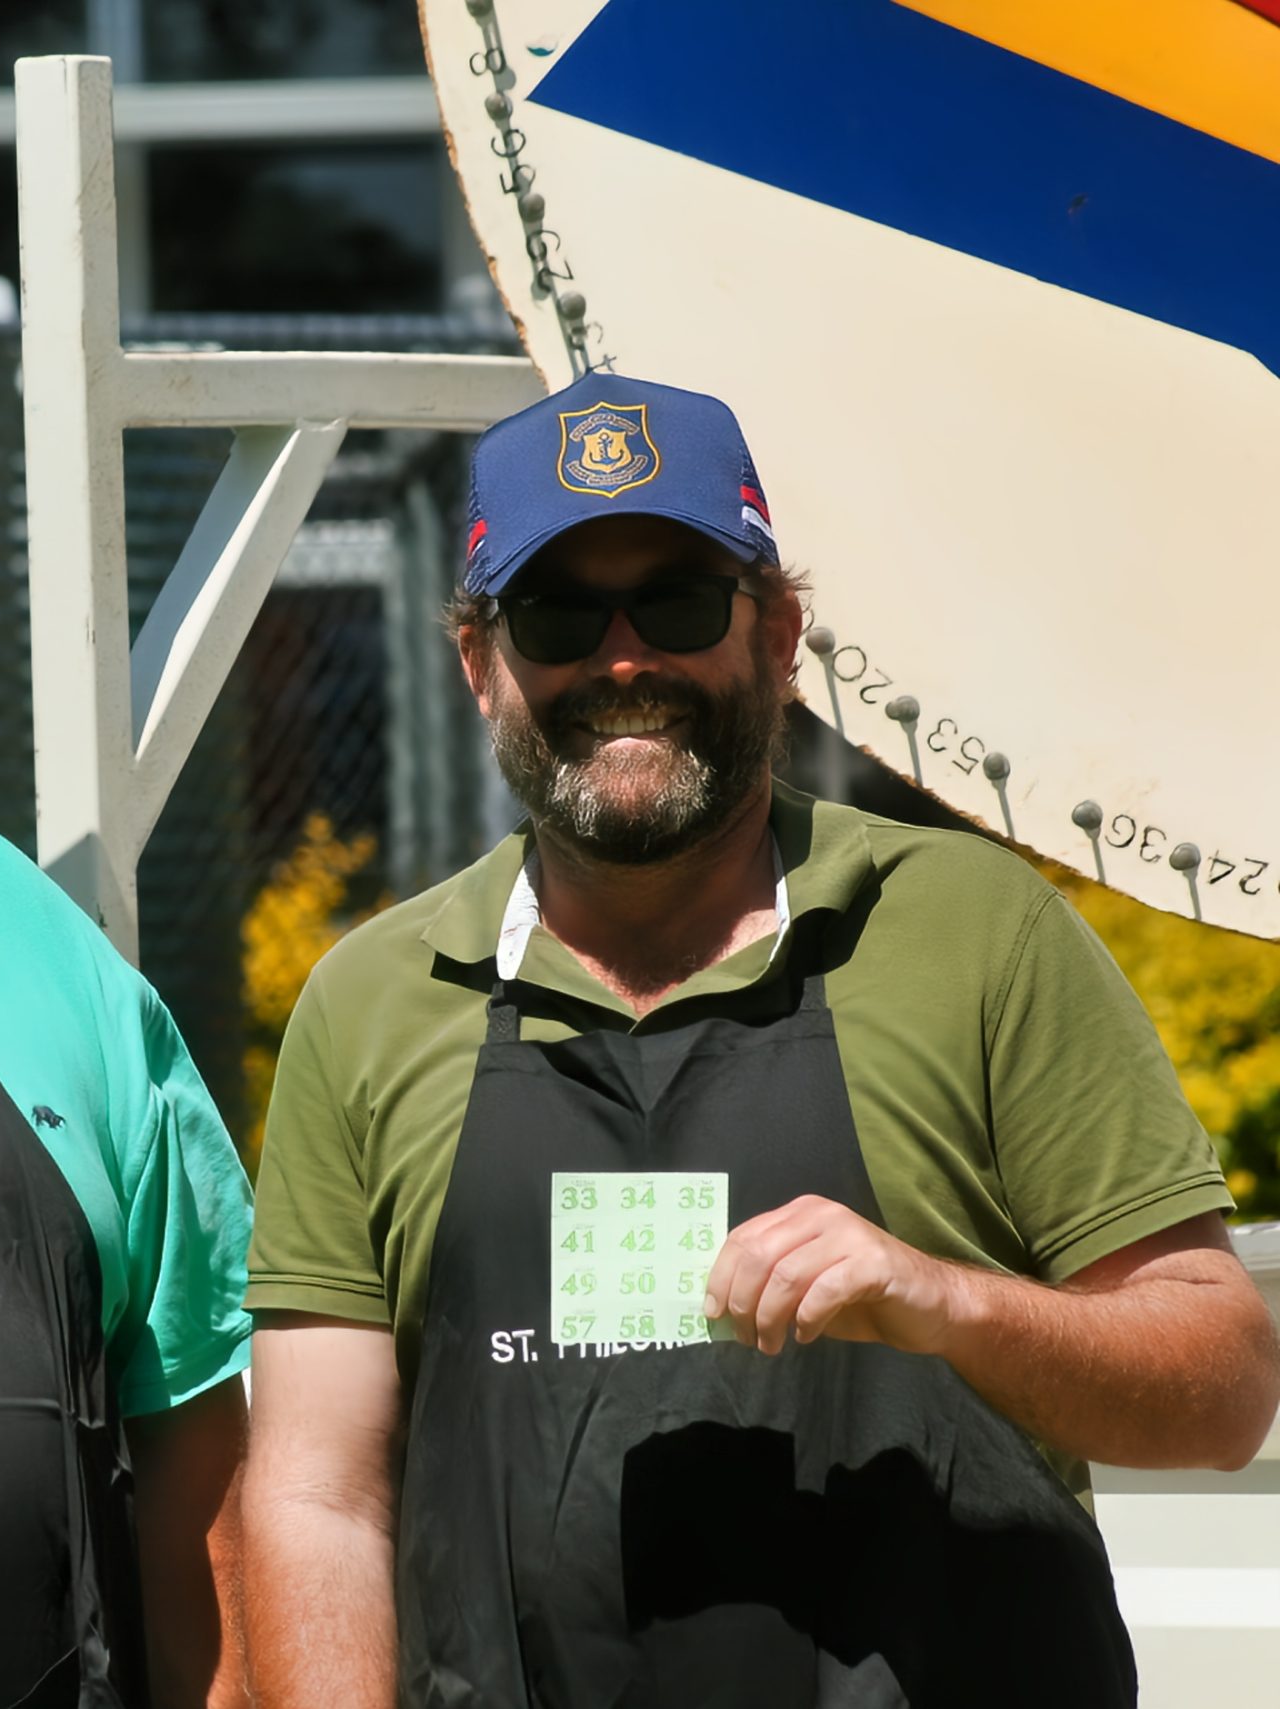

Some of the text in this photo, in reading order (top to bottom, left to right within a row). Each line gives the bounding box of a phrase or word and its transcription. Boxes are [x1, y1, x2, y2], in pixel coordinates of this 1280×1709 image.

[832, 646, 893, 705] 20
[926, 718, 986, 776] 53
[1106, 814, 1167, 864] 36
[1207, 850, 1269, 895] 24
[561, 1186, 715, 1210] 33 34 35
[561, 1229, 715, 1253] 41 42 43
[561, 1272, 597, 1296] 49
[619, 1272, 656, 1295] 50
[560, 1315, 597, 1339] 57
[619, 1315, 656, 1339] 58
[491, 1329, 538, 1363] ST.
